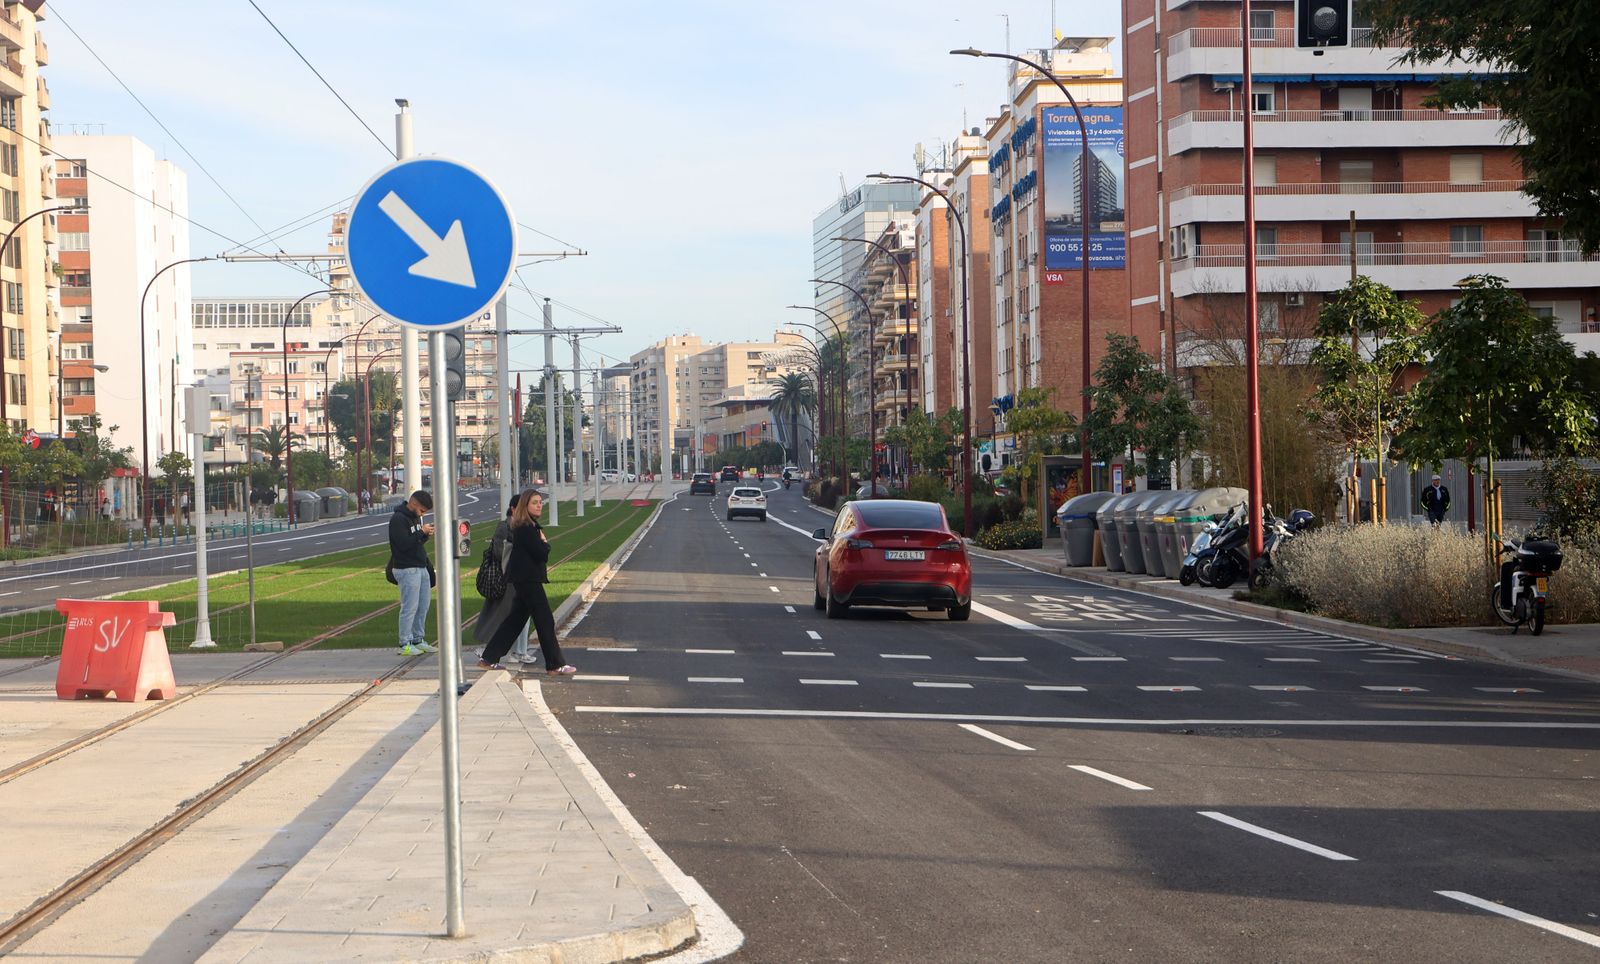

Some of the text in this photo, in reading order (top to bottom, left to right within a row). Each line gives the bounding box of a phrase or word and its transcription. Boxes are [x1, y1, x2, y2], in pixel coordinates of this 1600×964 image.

[1023, 602, 1170, 613] BUS
[1030, 612, 1239, 622] SOLO
[94, 616, 132, 653] SV
